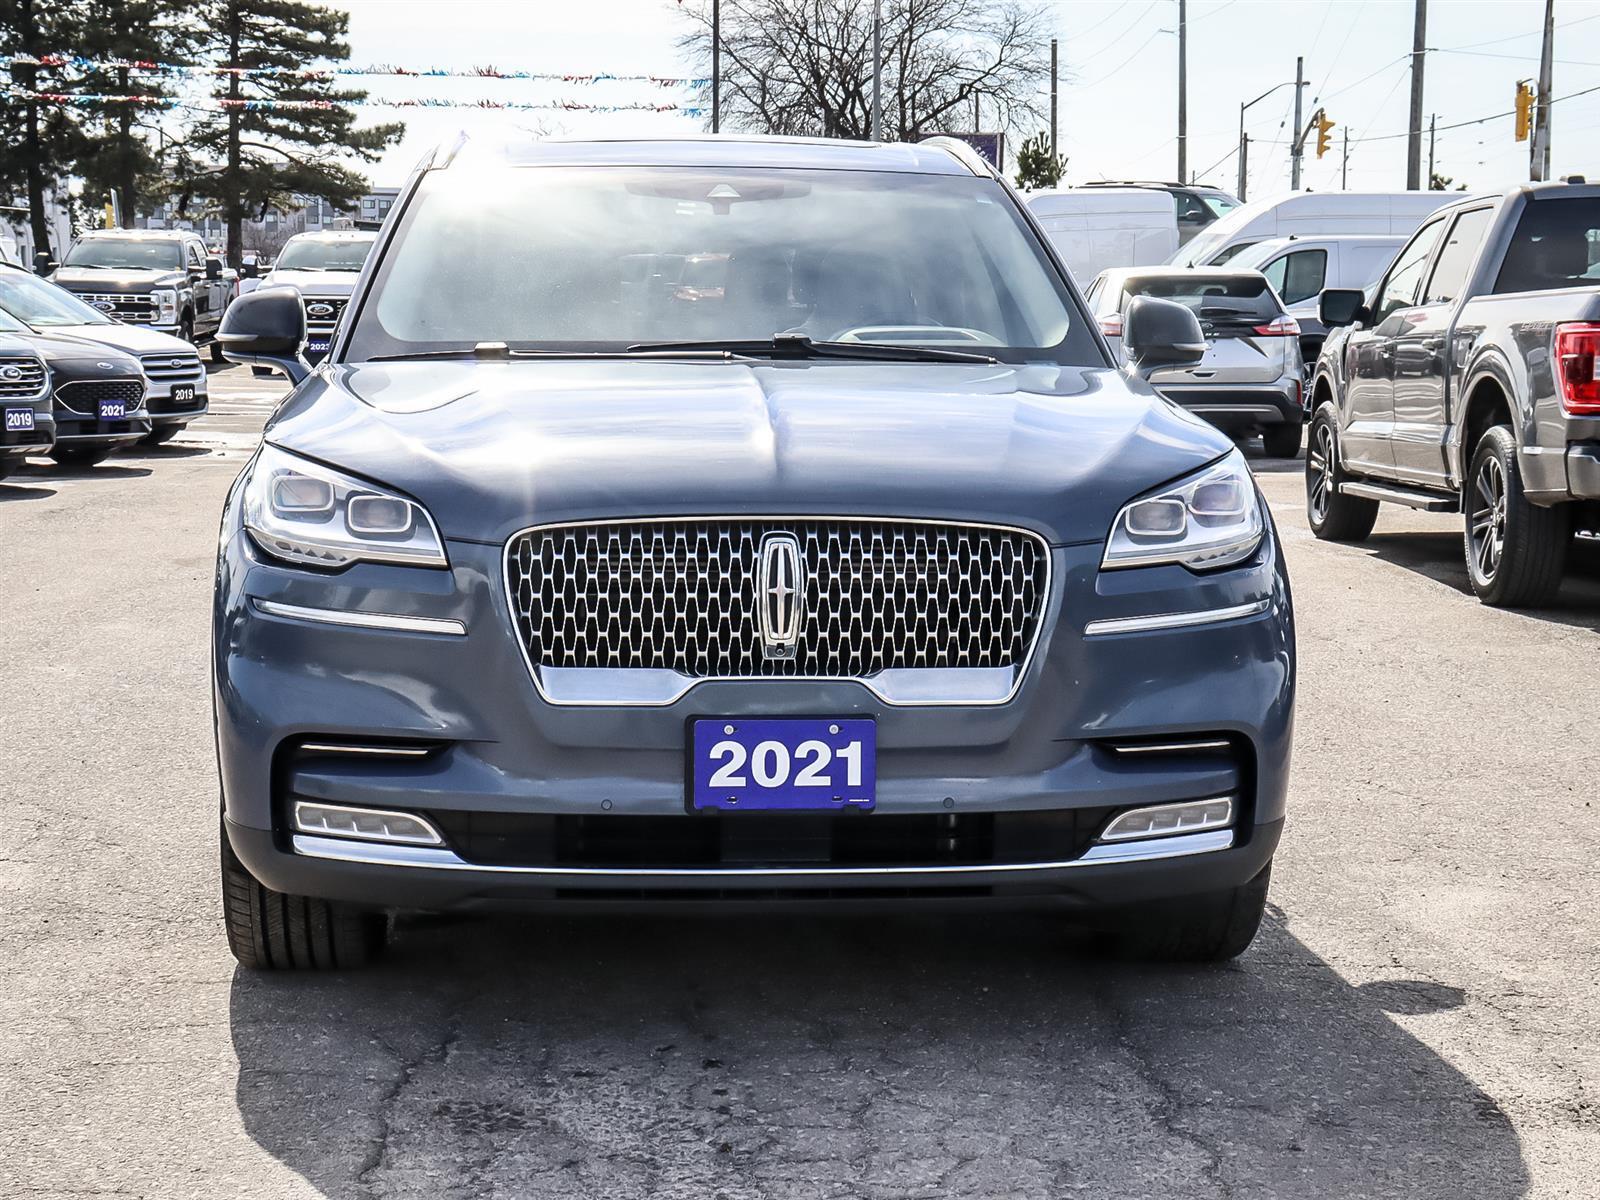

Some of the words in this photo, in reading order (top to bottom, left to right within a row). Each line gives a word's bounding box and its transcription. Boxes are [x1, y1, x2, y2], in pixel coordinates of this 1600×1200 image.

[175, 389, 194, 400] 2019
[101, 405, 125, 416] 2021
[7, 413, 32, 426] 2019
[709, 740, 862, 787] 2021
